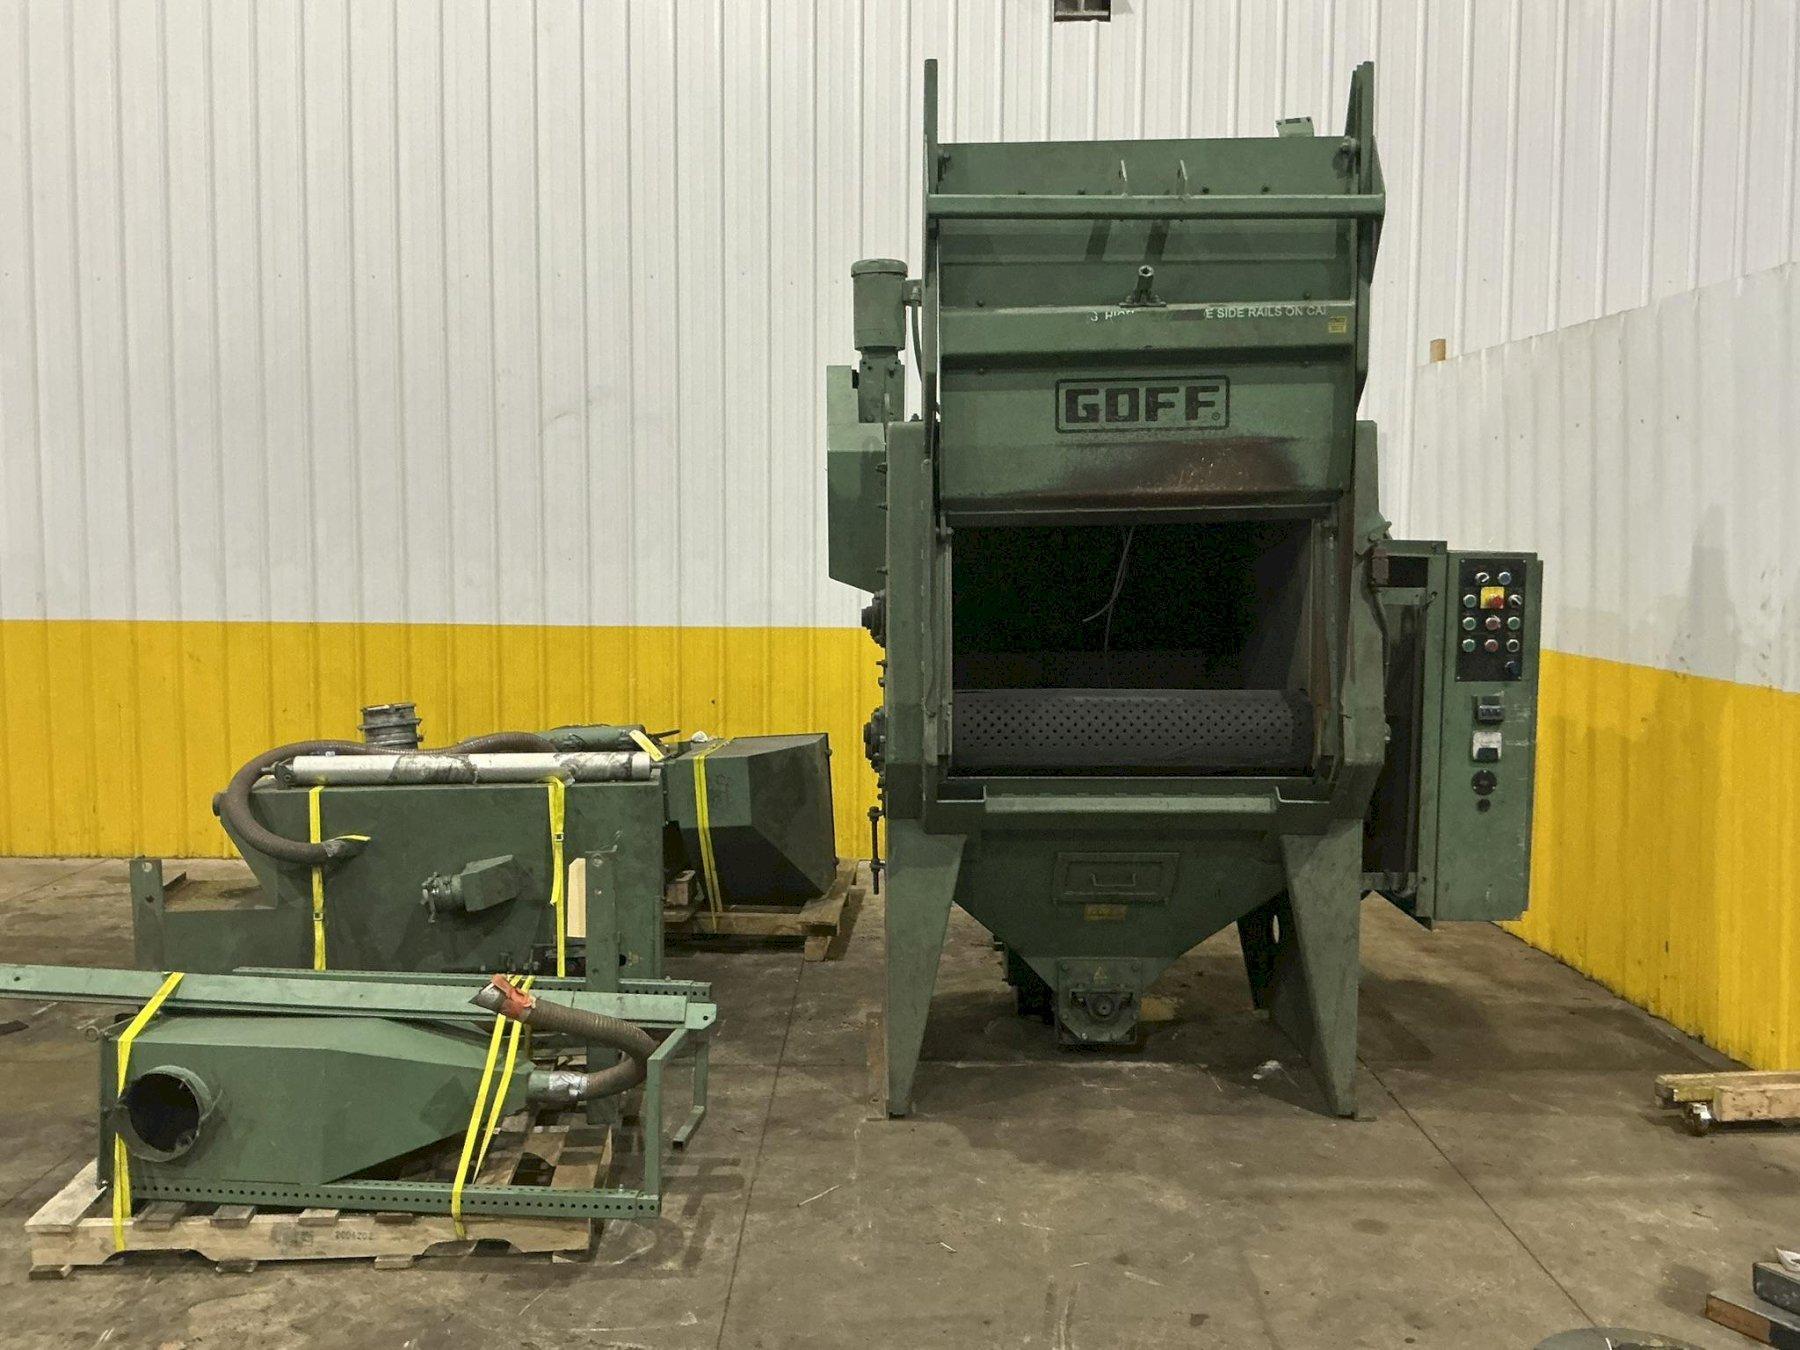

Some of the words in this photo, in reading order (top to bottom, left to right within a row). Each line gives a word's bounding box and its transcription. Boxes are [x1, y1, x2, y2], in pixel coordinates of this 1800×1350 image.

[1217, 307, 1245, 318] SIDE
[1248, 306, 1283, 317] RAILS
[1285, 305, 1303, 317] ON
[1065, 385, 1220, 423] GOFF
